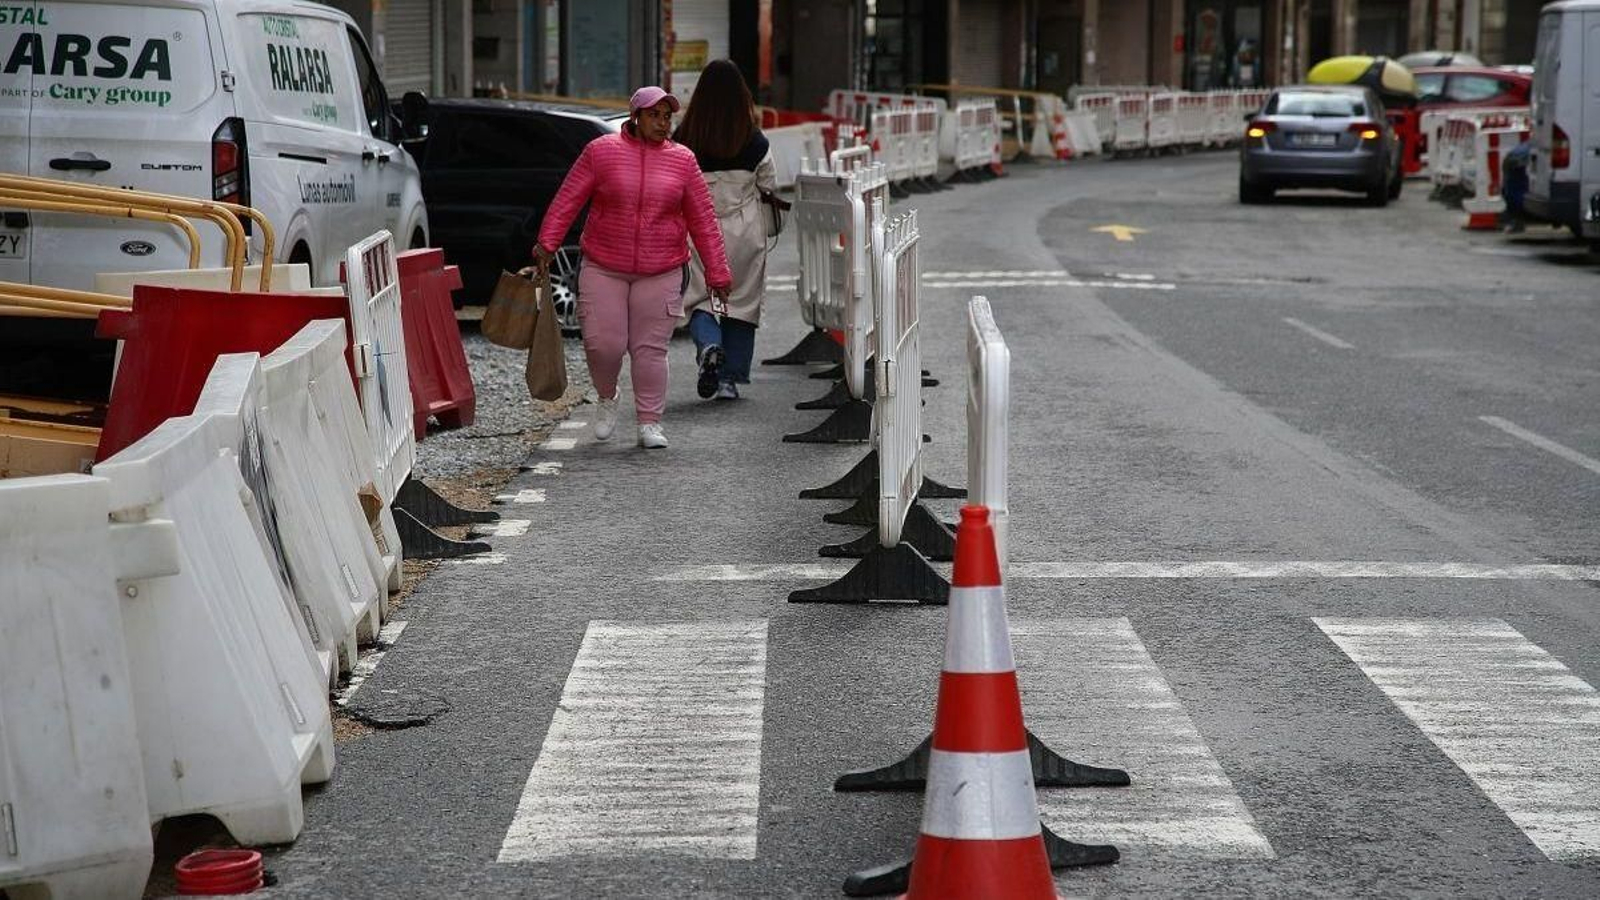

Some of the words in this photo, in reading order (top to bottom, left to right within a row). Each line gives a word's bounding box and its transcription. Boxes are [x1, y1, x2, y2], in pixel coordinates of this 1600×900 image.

[0, 33, 171, 80] ARSA
[267, 43, 334, 94] RALARSA
[1, 88, 28, 97] PART
[49, 83, 101, 104] Cary
[106, 87, 172, 107] group
[141, 163, 203, 171] CUSTOM
